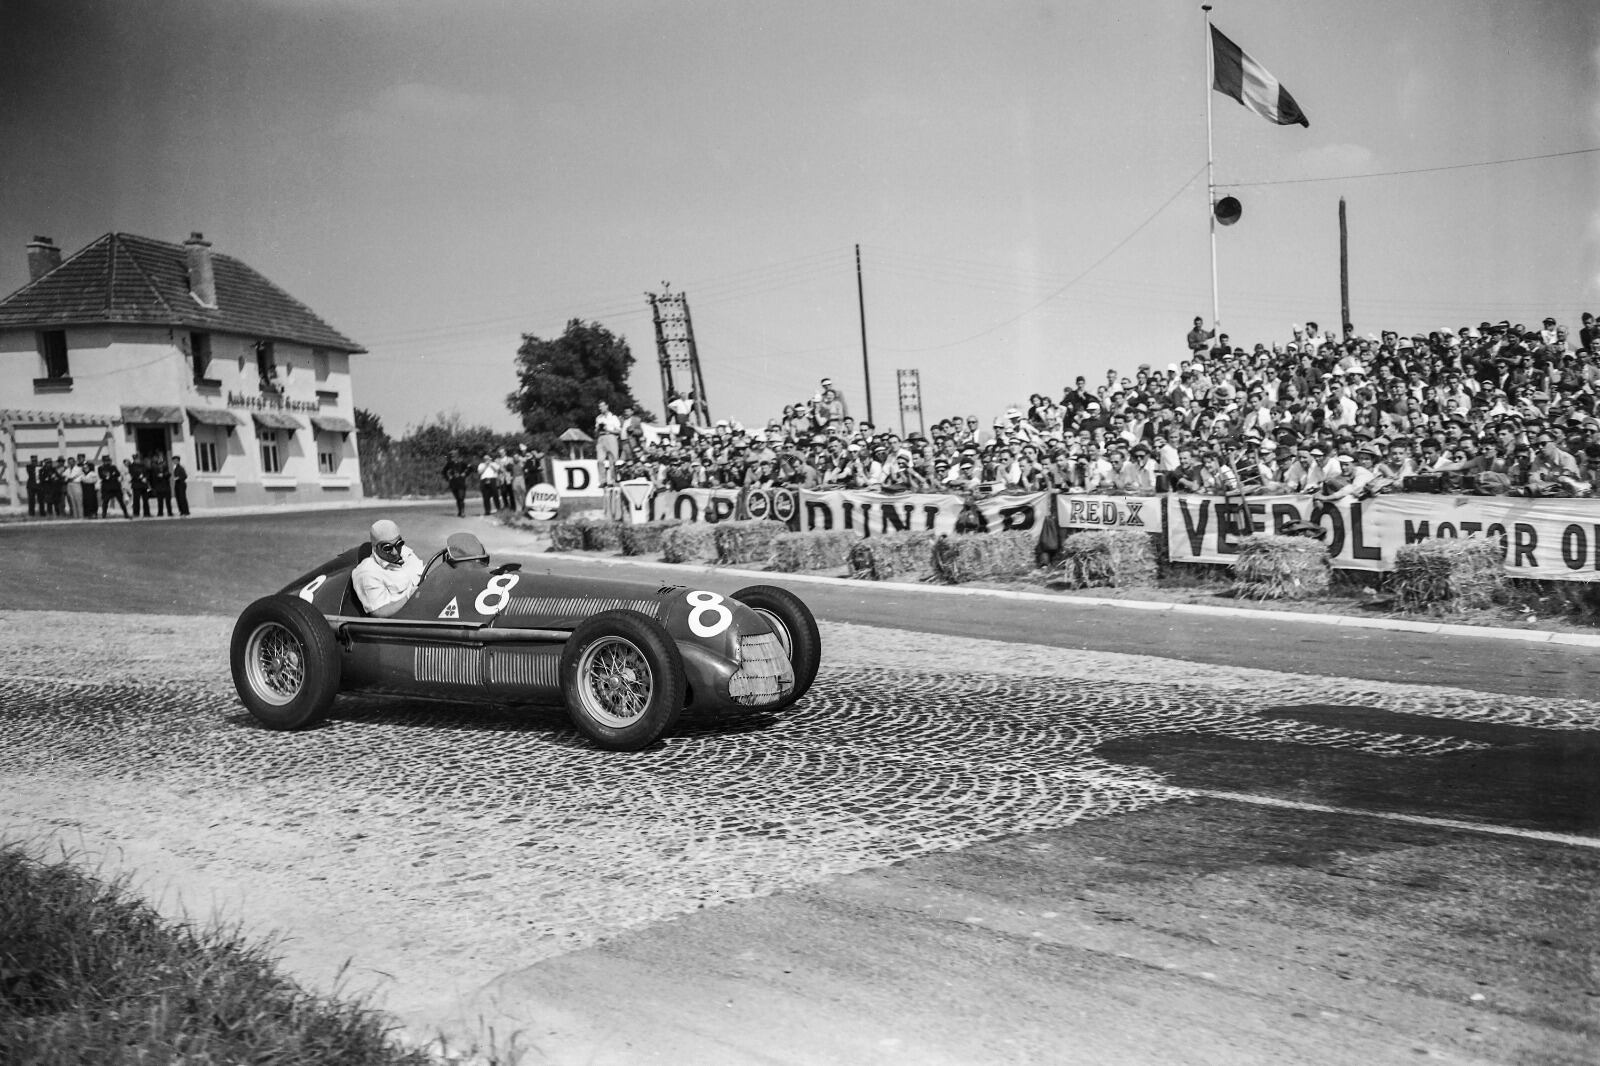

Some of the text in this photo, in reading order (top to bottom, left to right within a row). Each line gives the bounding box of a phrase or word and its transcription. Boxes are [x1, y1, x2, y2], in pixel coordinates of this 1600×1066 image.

[531, 491, 559, 504] VEEDOL
[564, 467, 590, 490] D
[804, 500, 1035, 538] DUNLP
[474, 573, 520, 616] 8
[686, 590, 733, 638] 8
